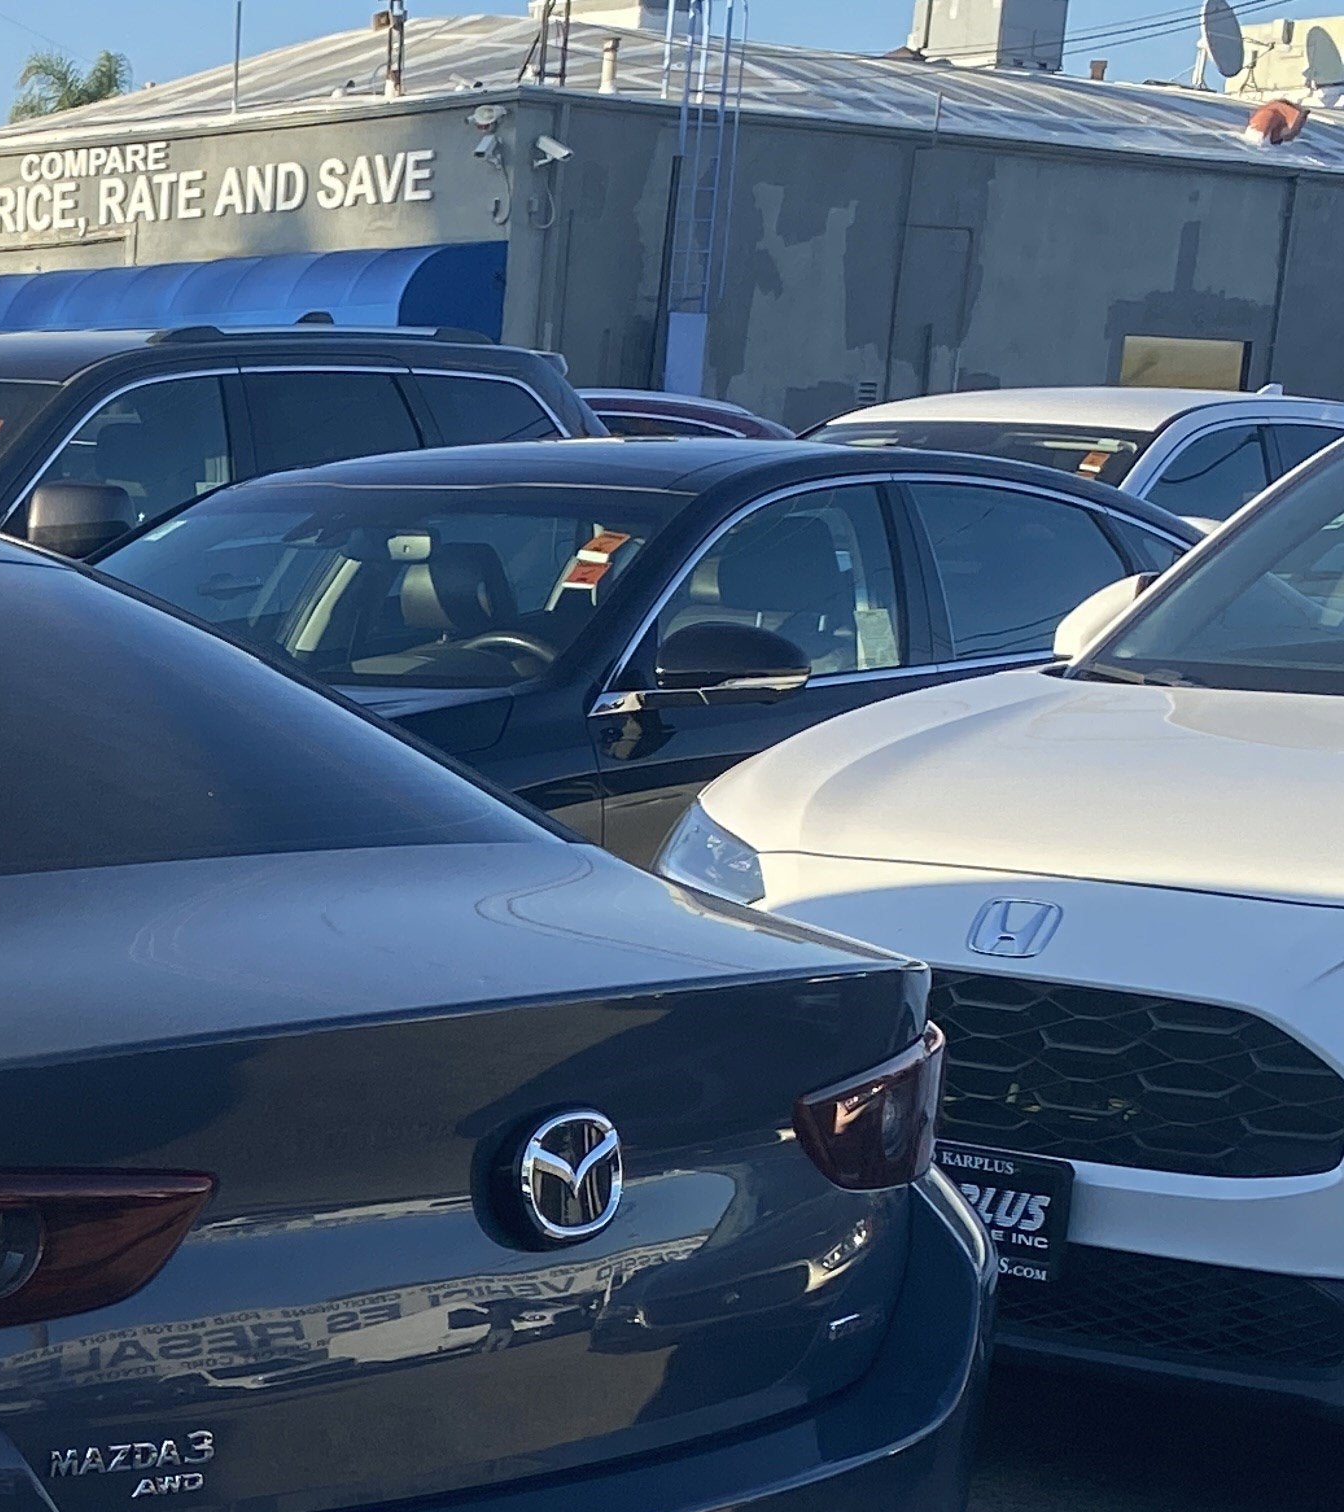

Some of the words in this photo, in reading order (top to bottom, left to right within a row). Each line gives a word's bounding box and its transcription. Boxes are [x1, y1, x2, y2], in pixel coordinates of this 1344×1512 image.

[20, 141, 169, 183] COMPARE
[98, 169, 206, 225] RATE
[213, 161, 309, 217] AND
[316, 149, 436, 210] SAVE
[942, 1150, 1016, 1175] KARPLUS
[960, 1182, 1052, 1232] PLUS
[1012, 1232, 1050, 1250] INC
[131, 1472, 204, 1498] AWD
